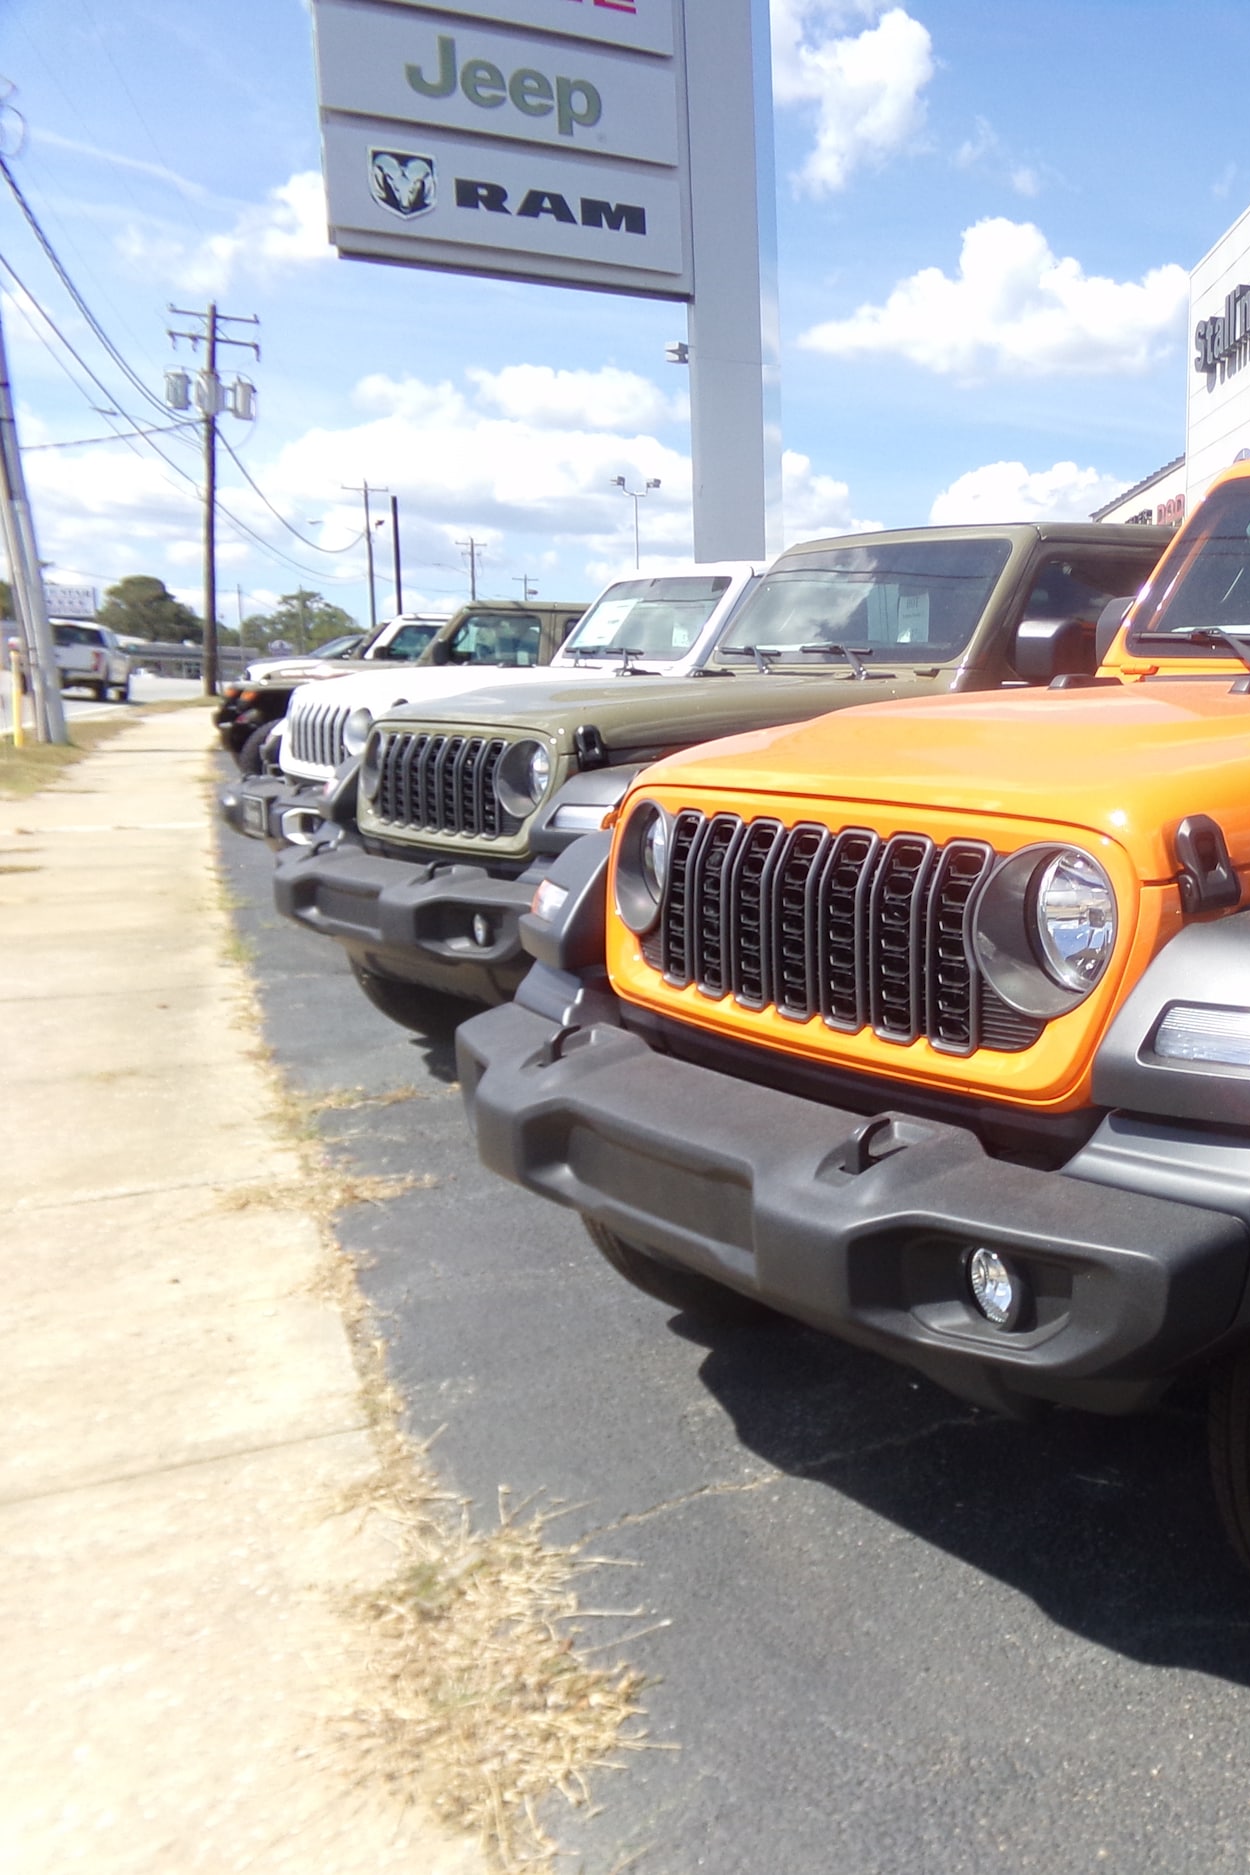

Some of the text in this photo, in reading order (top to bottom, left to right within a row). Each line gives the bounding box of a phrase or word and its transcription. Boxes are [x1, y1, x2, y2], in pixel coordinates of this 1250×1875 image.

[404, 35, 602, 136] Jeep
[454, 178, 647, 236] RAM
[1157, 494, 1186, 526] DOD
